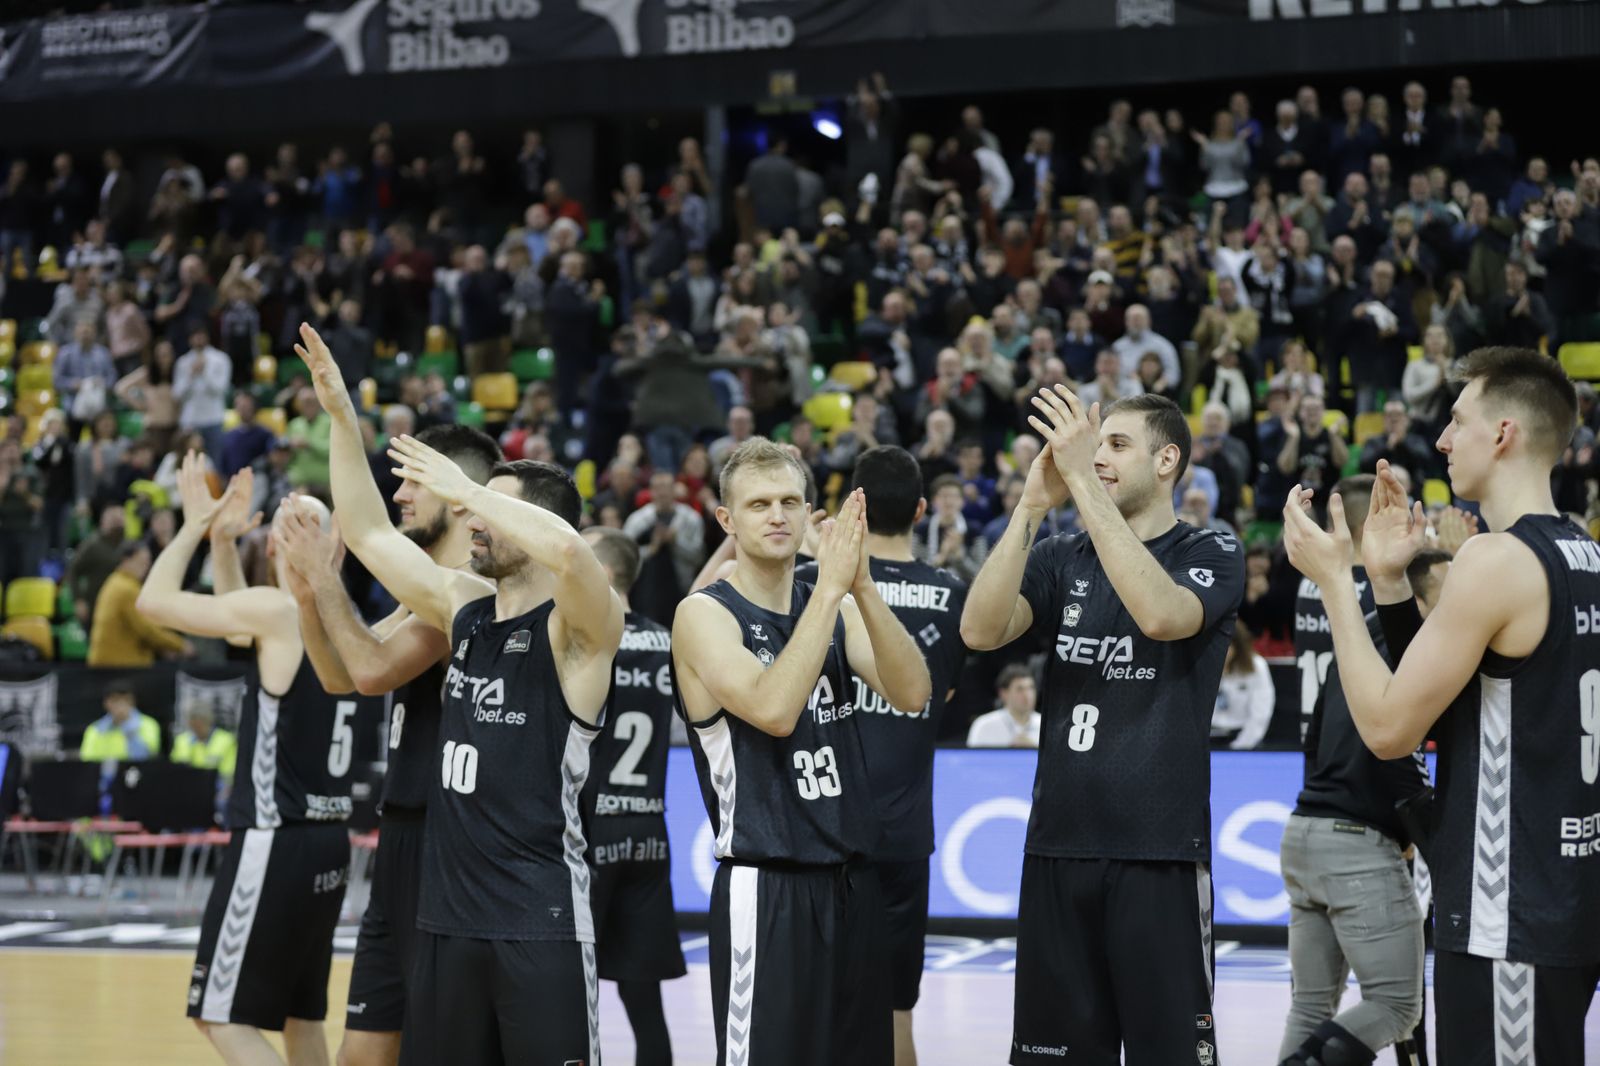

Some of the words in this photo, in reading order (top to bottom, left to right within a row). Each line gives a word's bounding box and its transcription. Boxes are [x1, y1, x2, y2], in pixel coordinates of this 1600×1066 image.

[387, 30, 509, 72] Bilbao
[666, 12, 795, 54] Bilbao
[876, 580, 951, 612] DRÍGUEZ
[1106, 664, 1156, 680] bet.es
[477, 706, 526, 725] bet.es
[1068, 703, 1099, 752] 8
[327, 700, 357, 777] 5
[608, 711, 653, 786] 2
[441, 740, 478, 794] 10
[793, 745, 842, 800] 33
[1022, 1044, 1031, 1053] EL
[1032, 1045, 1066, 1056] CORREO
